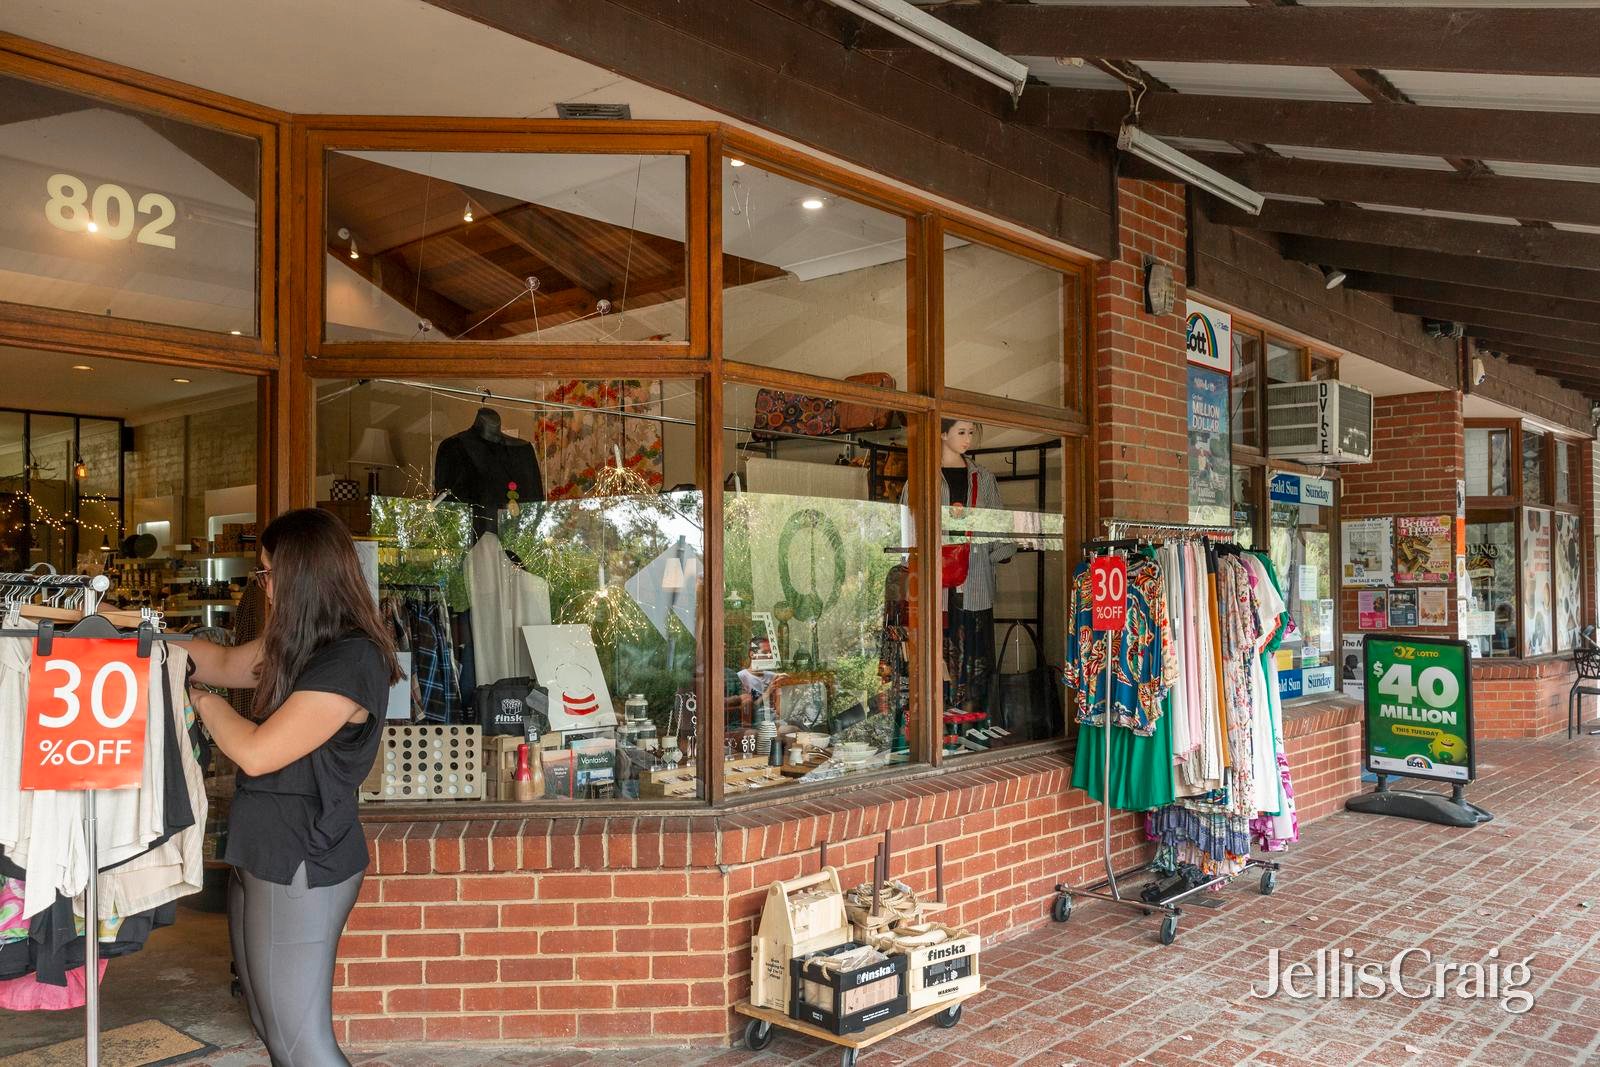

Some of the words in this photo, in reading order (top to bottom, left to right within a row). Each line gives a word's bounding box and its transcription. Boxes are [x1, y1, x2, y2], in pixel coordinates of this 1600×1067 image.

[45, 173, 176, 249] 802
[1270, 480, 1285, 493] rald
[1286, 481, 1299, 496] Sun
[1305, 484, 1330, 502] Sunday
[1401, 519, 1435, 528] Better
[1409, 526, 1449, 536] Homes
[1095, 567, 1124, 602] 30
[1096, 606, 1123, 619] %OFF
[1393, 646, 1416, 659] OZ
[1417, 650, 1439, 658] LOTTO
[1288, 677, 1301, 691] Sun
[1307, 675, 1332, 689] Sunday
[1373, 660, 1459, 708] $40
[38, 659, 138, 729] 30
[495, 714, 523, 722] finsk
[1380, 704, 1457, 725] MILLION
[1411, 728, 1439, 736] TUESDAY
[39, 739, 132, 766] %OFF
[928, 944, 966, 961] finska
[861, 965, 891, 983] finska
[937, 986, 959, 996] WARNING
